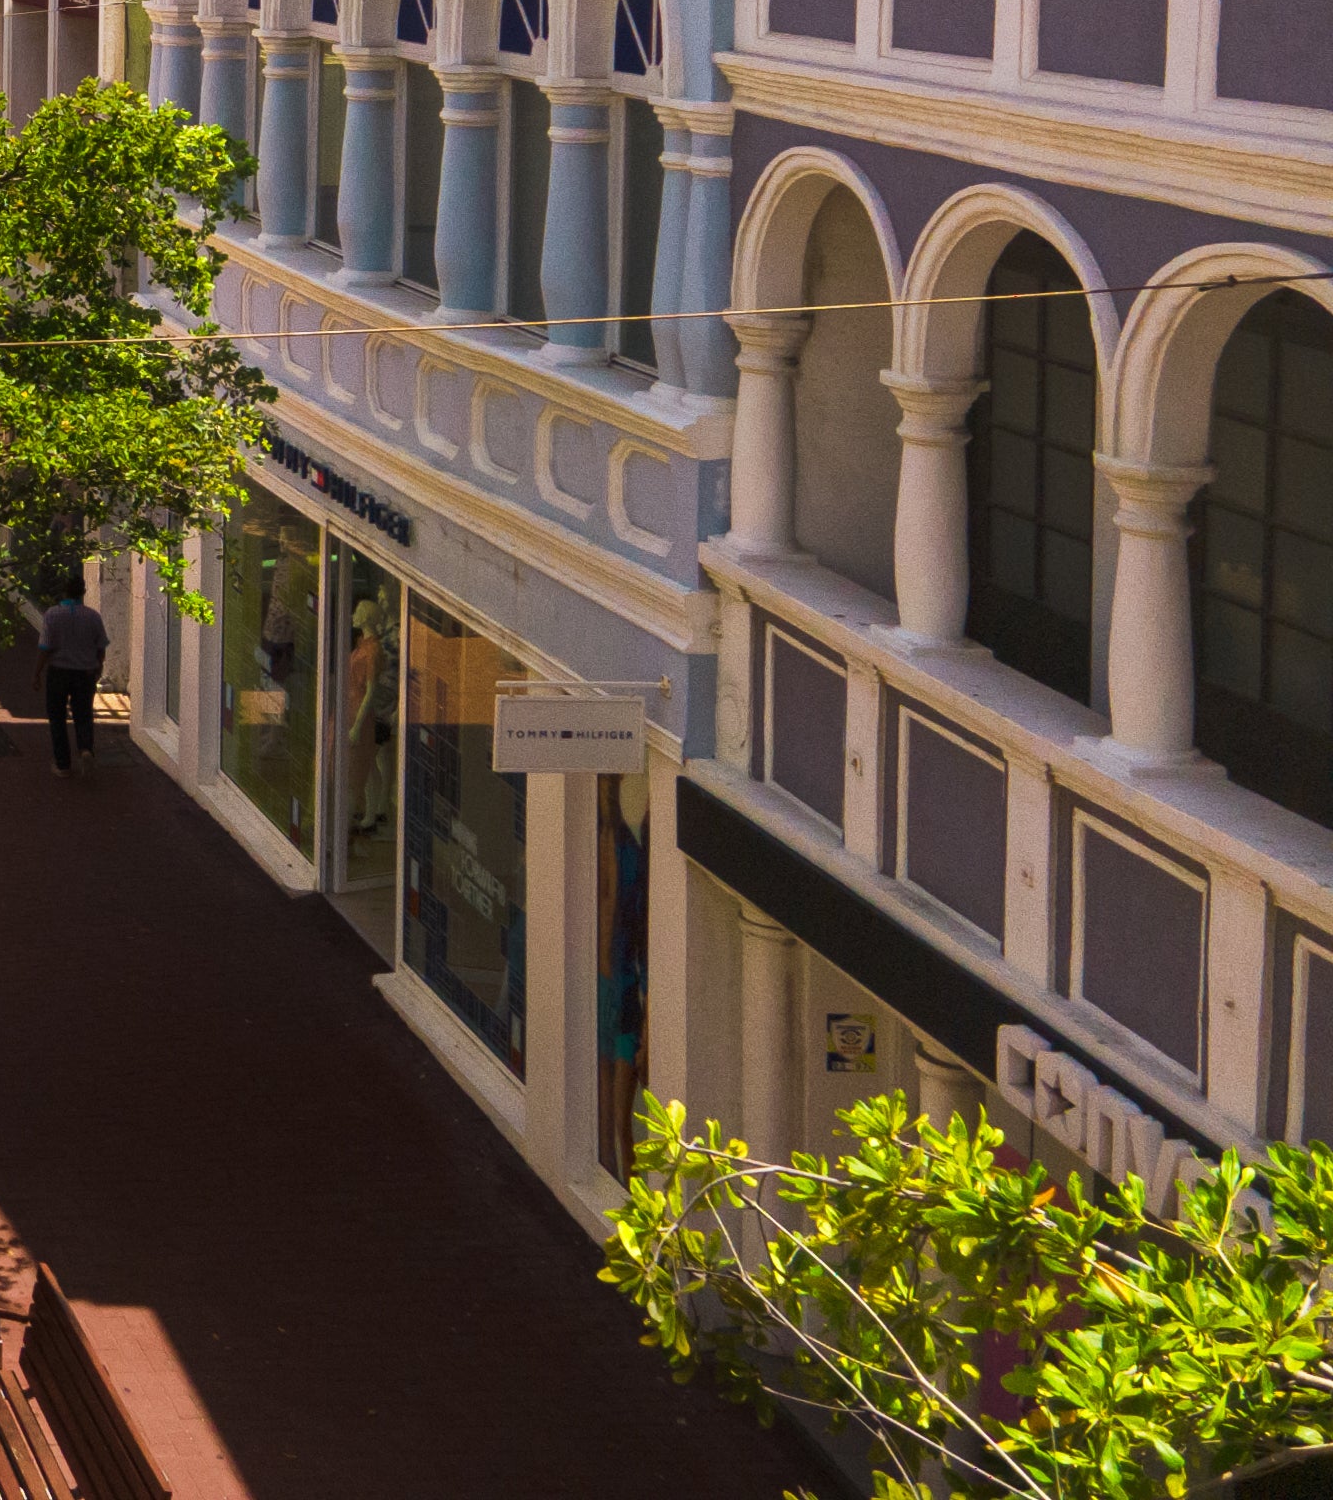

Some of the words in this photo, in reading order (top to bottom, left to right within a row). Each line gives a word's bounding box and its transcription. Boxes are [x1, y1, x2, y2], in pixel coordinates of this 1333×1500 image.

[330, 470, 411, 548] HILFIGER
[507, 730, 558, 739] TOMMY
[576, 730, 633, 740] HILFIGER
